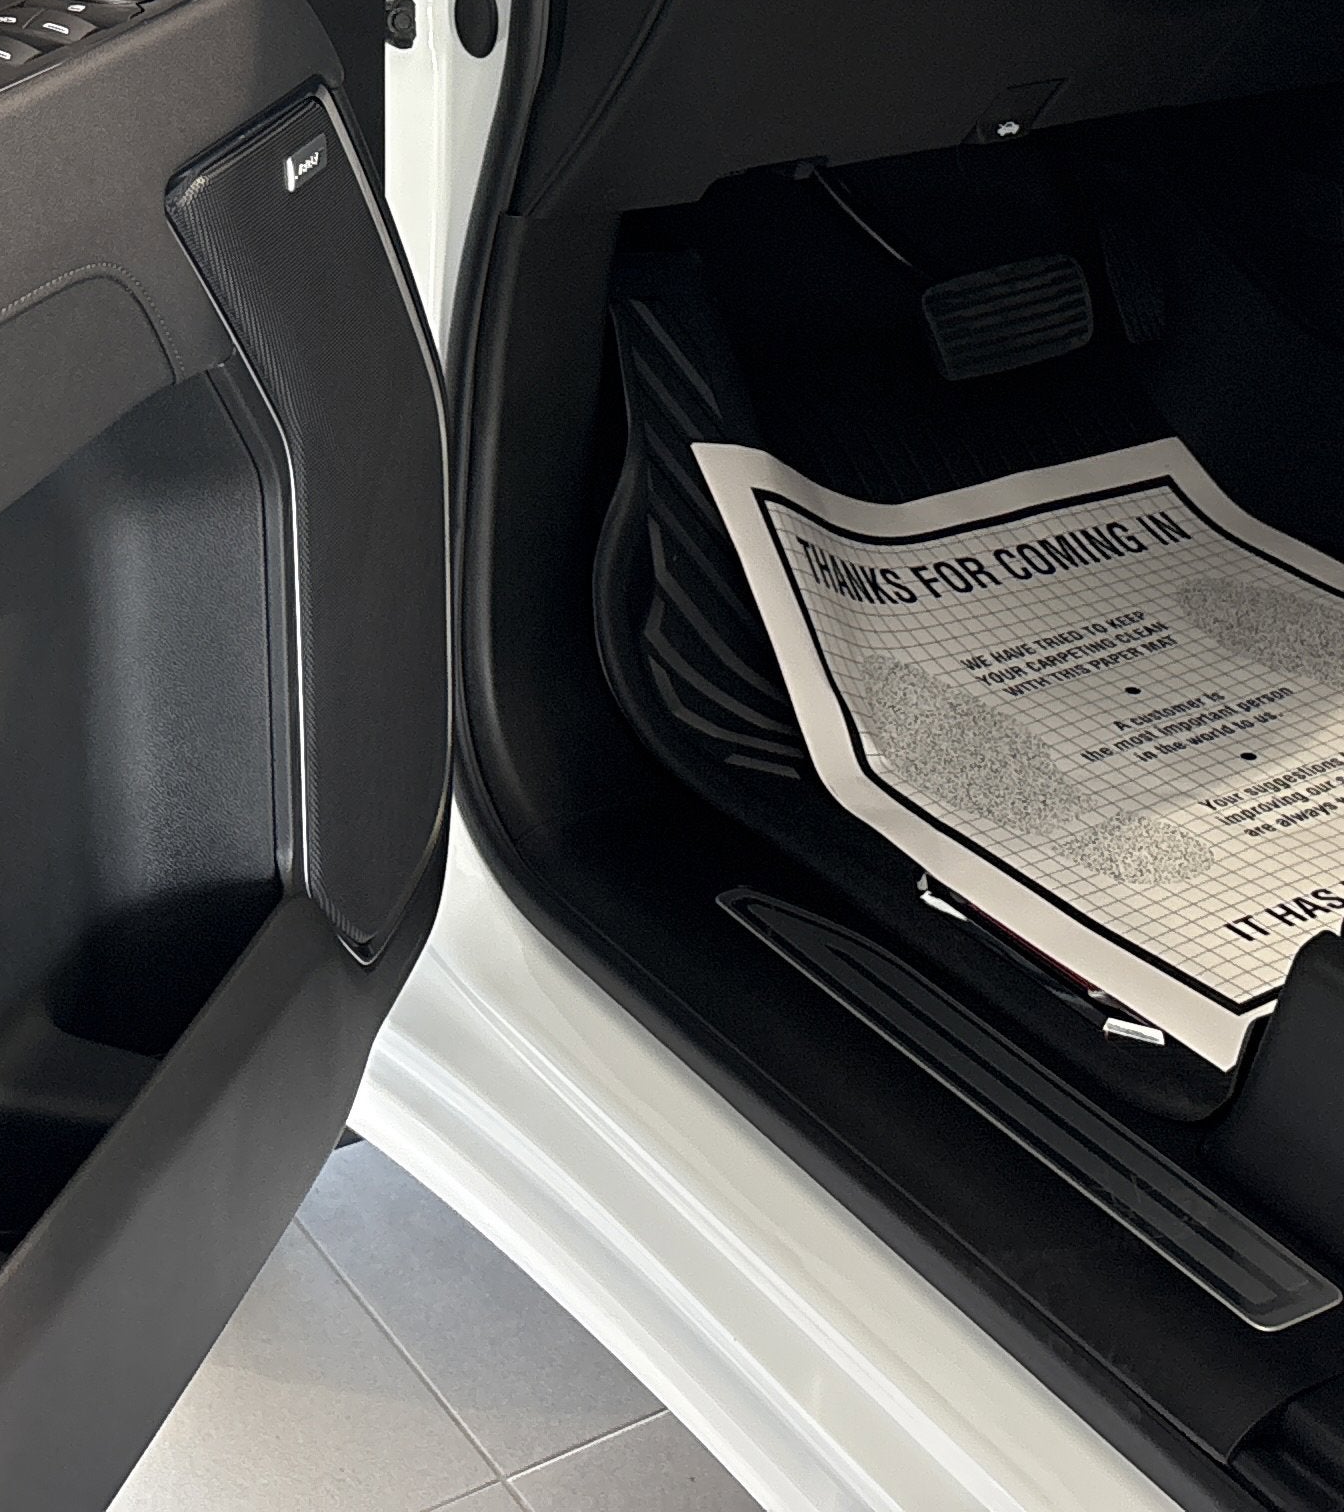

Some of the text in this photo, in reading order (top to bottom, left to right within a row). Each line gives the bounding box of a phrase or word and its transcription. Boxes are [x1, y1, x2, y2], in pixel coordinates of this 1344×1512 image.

[796, 511, 1192, 605] THANKS FOR COMING IN
[960, 610, 1146, 671] WE HAVE TRIED TO KEEP
[975, 621, 1170, 687] YOUR CARPETING CLEAN
[1002, 634, 1178, 697] WITH THIS PAPER MAT
[1080, 686, 1294, 763] the most important person
[1113, 719, 1132, 731] A
[1130, 697, 1206, 727] customer
[1133, 710, 1284, 763] in the world to us.
[1198, 791, 1244, 811] Your
[1244, 756, 1344, 796] suggestions
[1215, 789, 1309, 826] improving
[1306, 779, 1338, 797] our
[1244, 822, 1277, 837] are
[1276, 800, 1338, 828] always
[1224, 914, 1271, 942] IT
